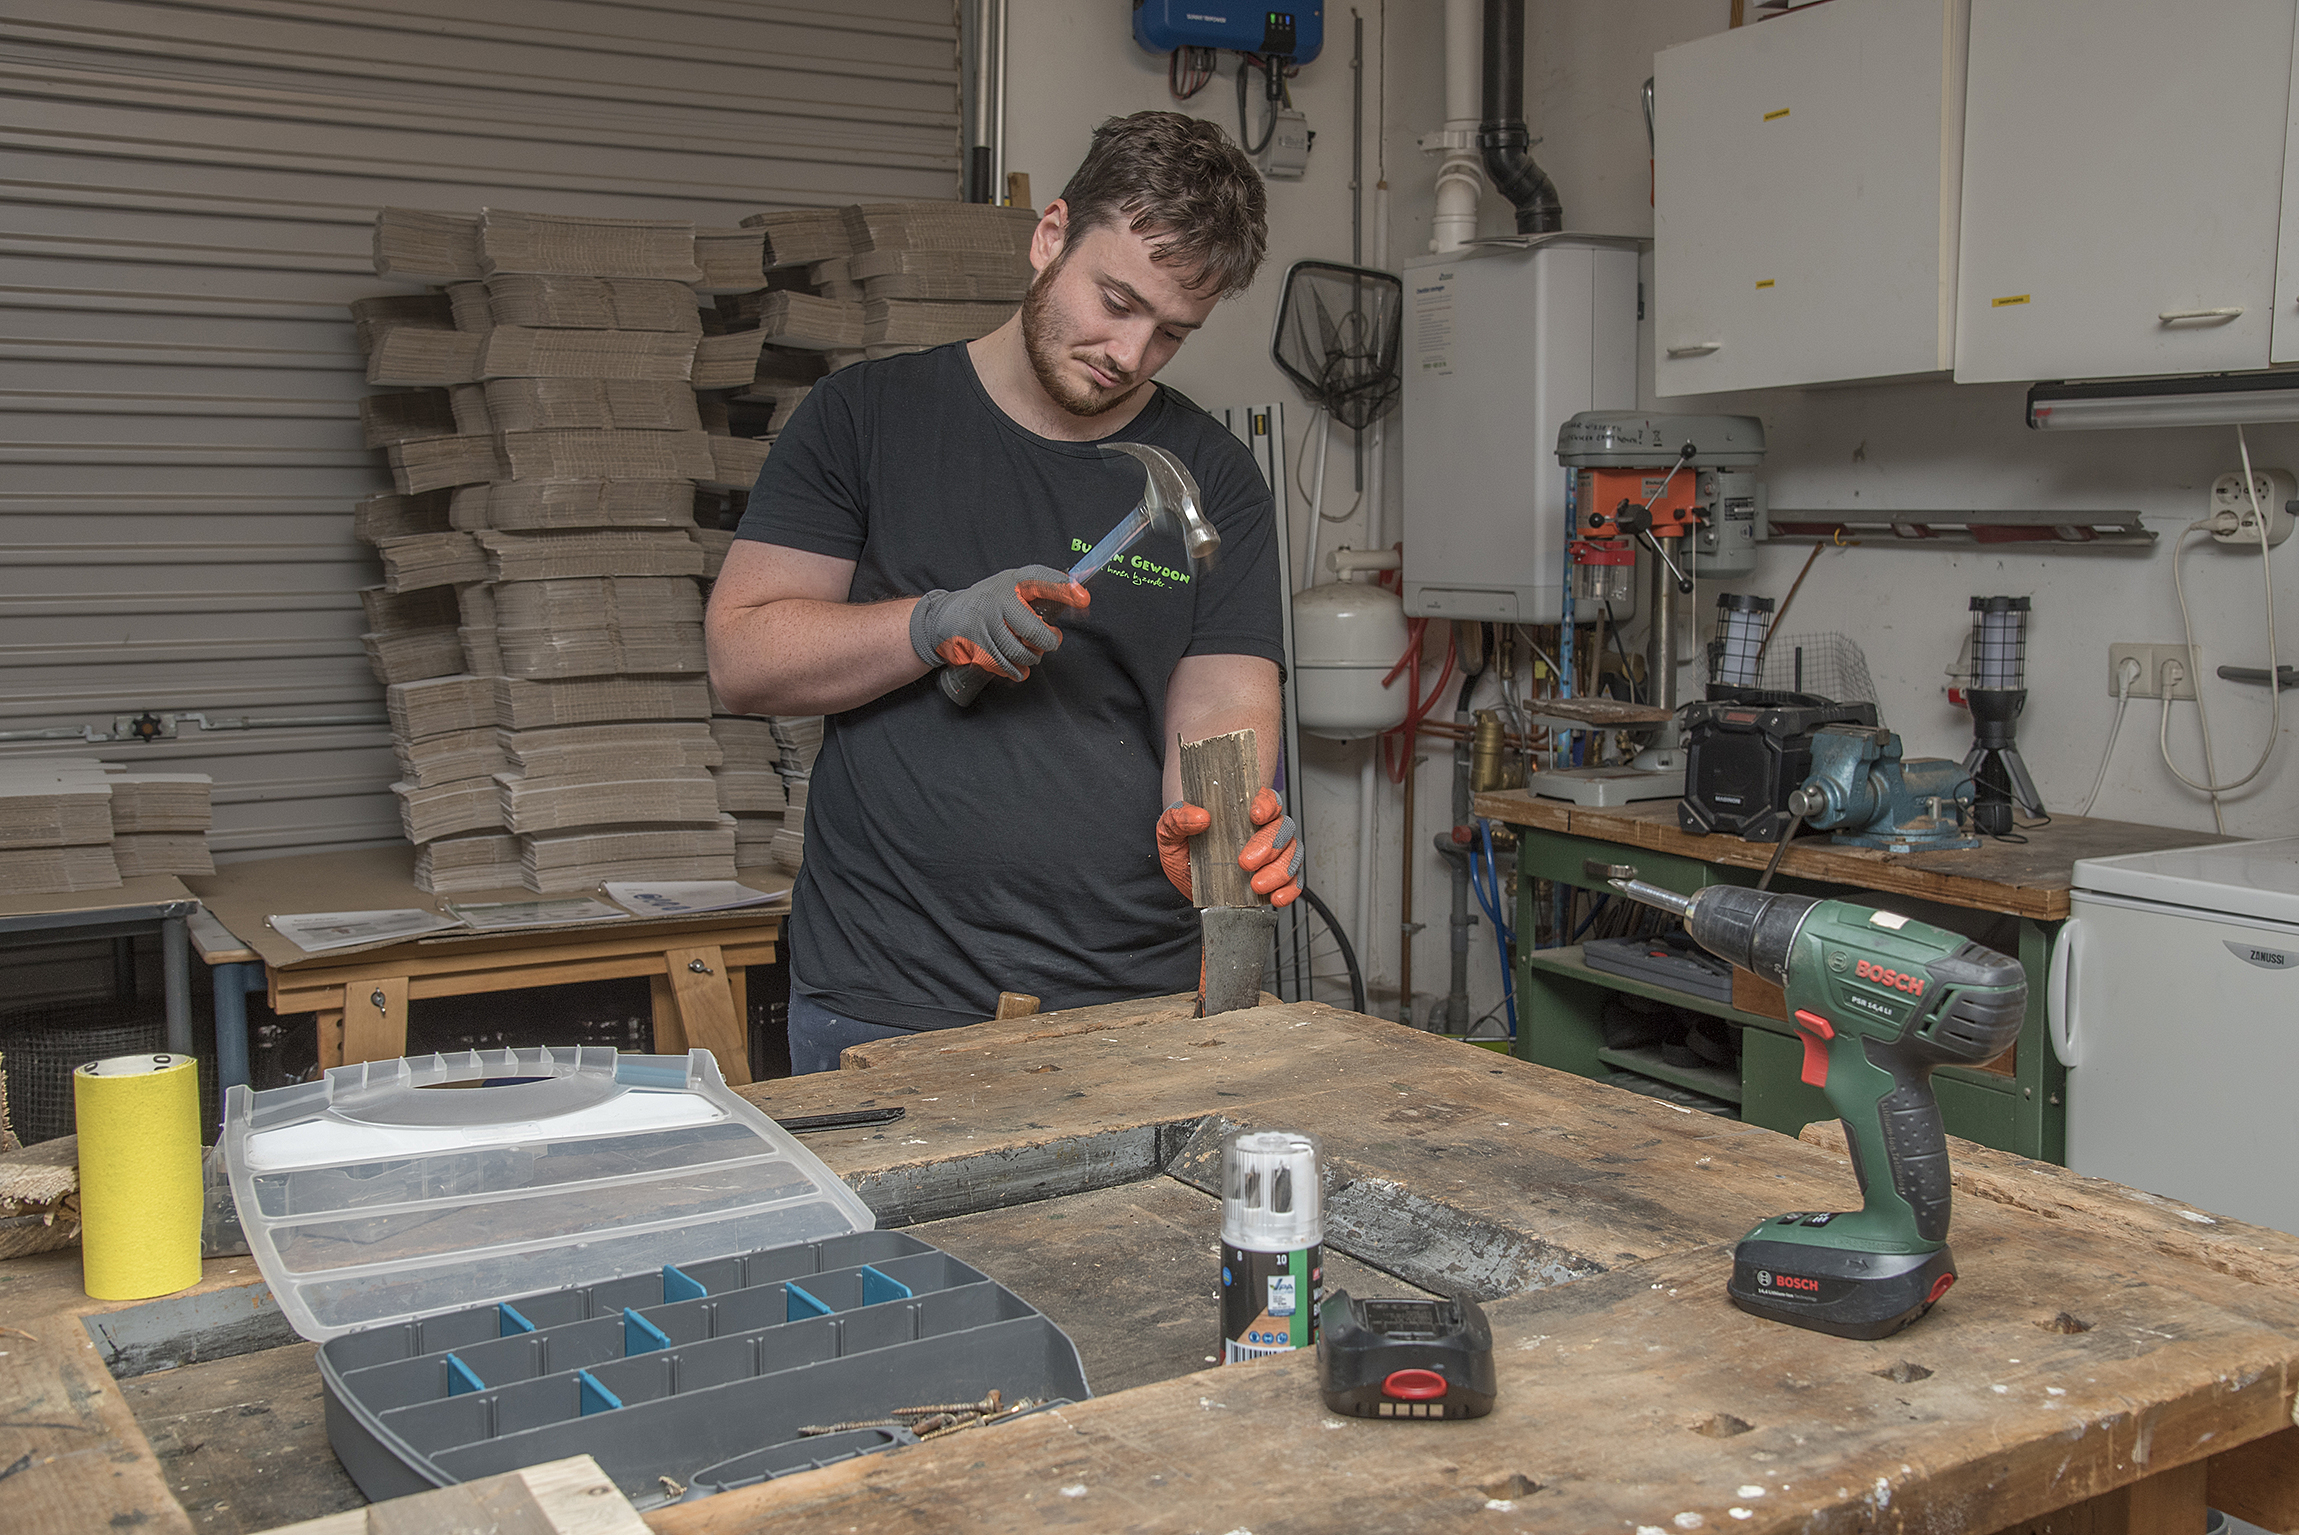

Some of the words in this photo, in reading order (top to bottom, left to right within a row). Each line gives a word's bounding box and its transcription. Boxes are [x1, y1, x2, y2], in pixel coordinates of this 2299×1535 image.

[1071, 538, 1125, 564] BUN
[2250, 950, 2285, 965] ZANUSSI
[1855, 959, 1925, 997] BOSCH
[1851, 996, 1867, 1007] PSR
[1237, 1250, 1243, 1261] 8
[1276, 1254, 1288, 1266] 10
[1776, 1275, 1819, 1292] BOSCH
